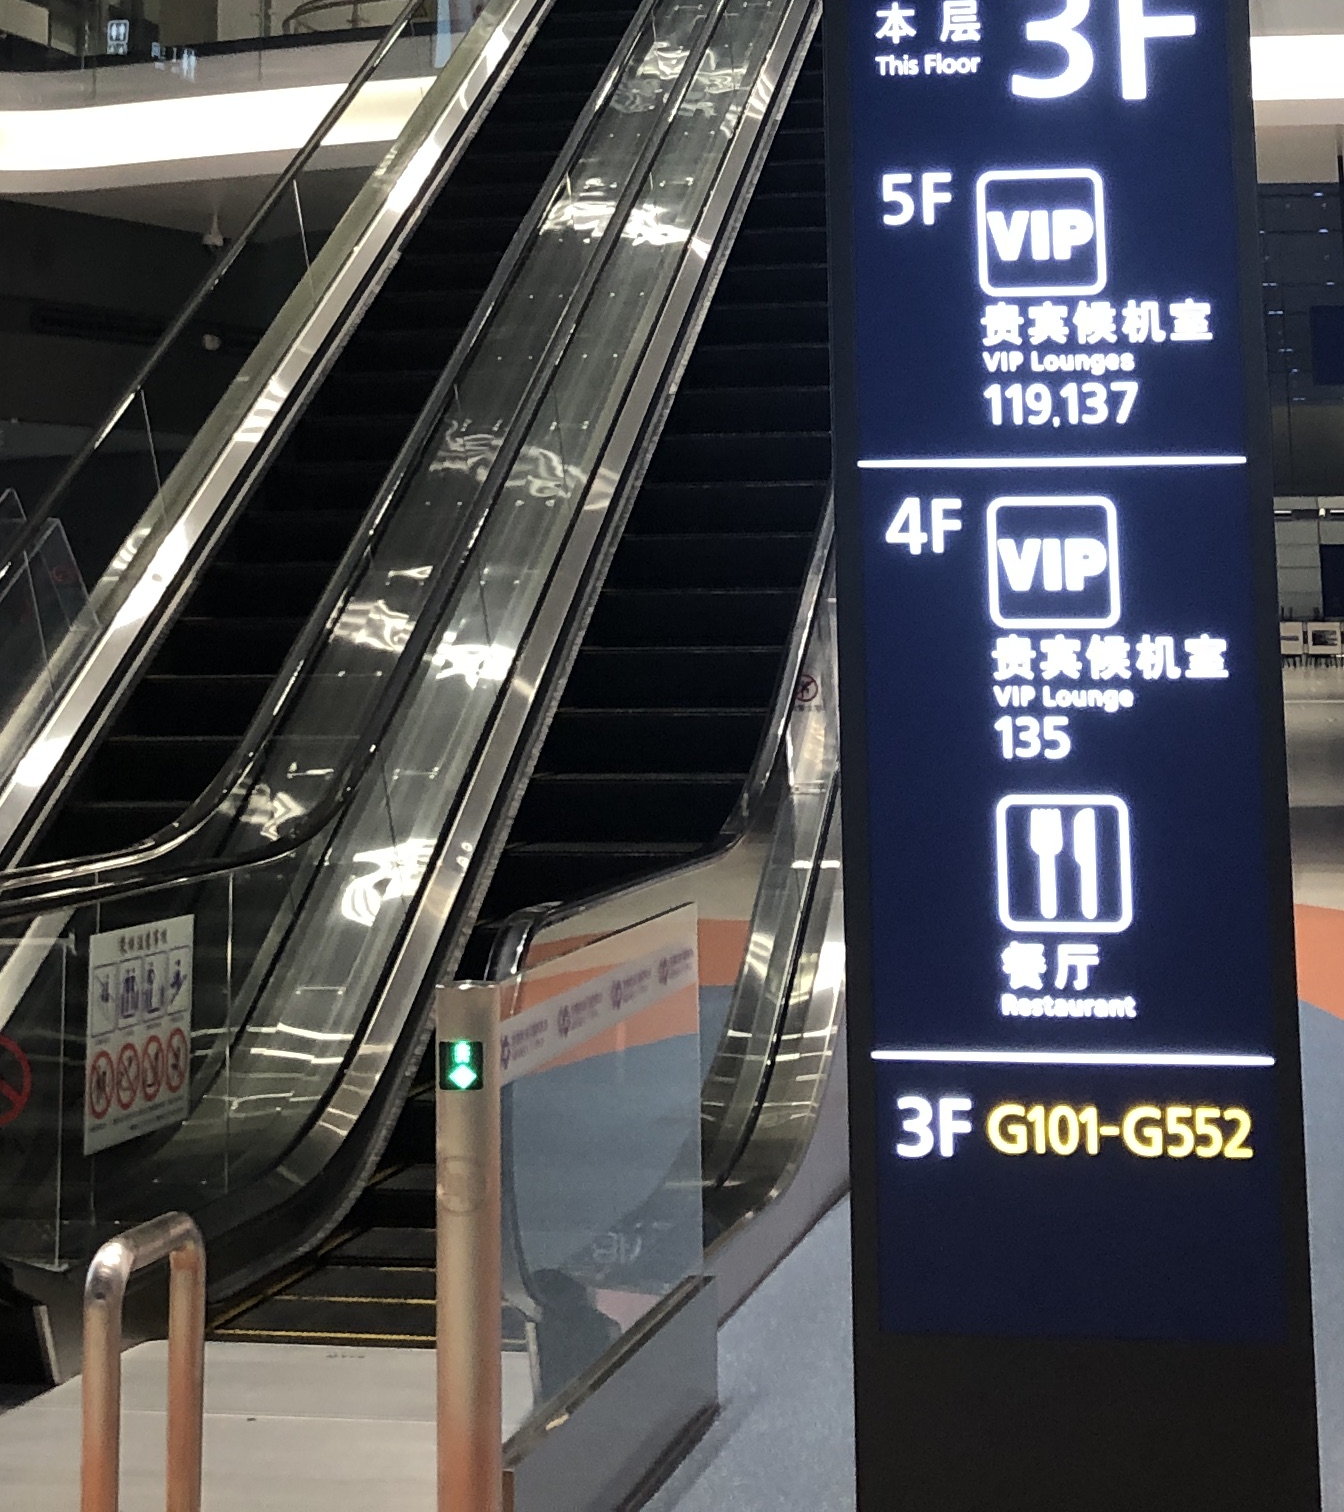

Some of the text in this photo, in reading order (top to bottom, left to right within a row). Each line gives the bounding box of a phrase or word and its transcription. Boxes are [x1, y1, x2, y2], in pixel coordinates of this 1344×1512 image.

[876, 0, 981, 44] 本层
[875, 53, 981, 75] This Floor
[883, 172, 1098, 263] 5F VIP
[981, 296, 1212, 346] 贵宾候机室
[983, 351, 1134, 375] VIP Lounges
[984, 382, 1138, 427] 119,137
[886, 498, 1107, 592] 4F VIP
[992, 634, 1228, 680] 贵宾候机室
[993, 685, 1133, 712] VIP Lounge
[994, 716, 1070, 759] 135
[1001, 941, 1099, 990] 餐厅
[1001, 993, 1136, 1017] Restaurant
[897, 1096, 1253, 1157] 3F G101-G552
